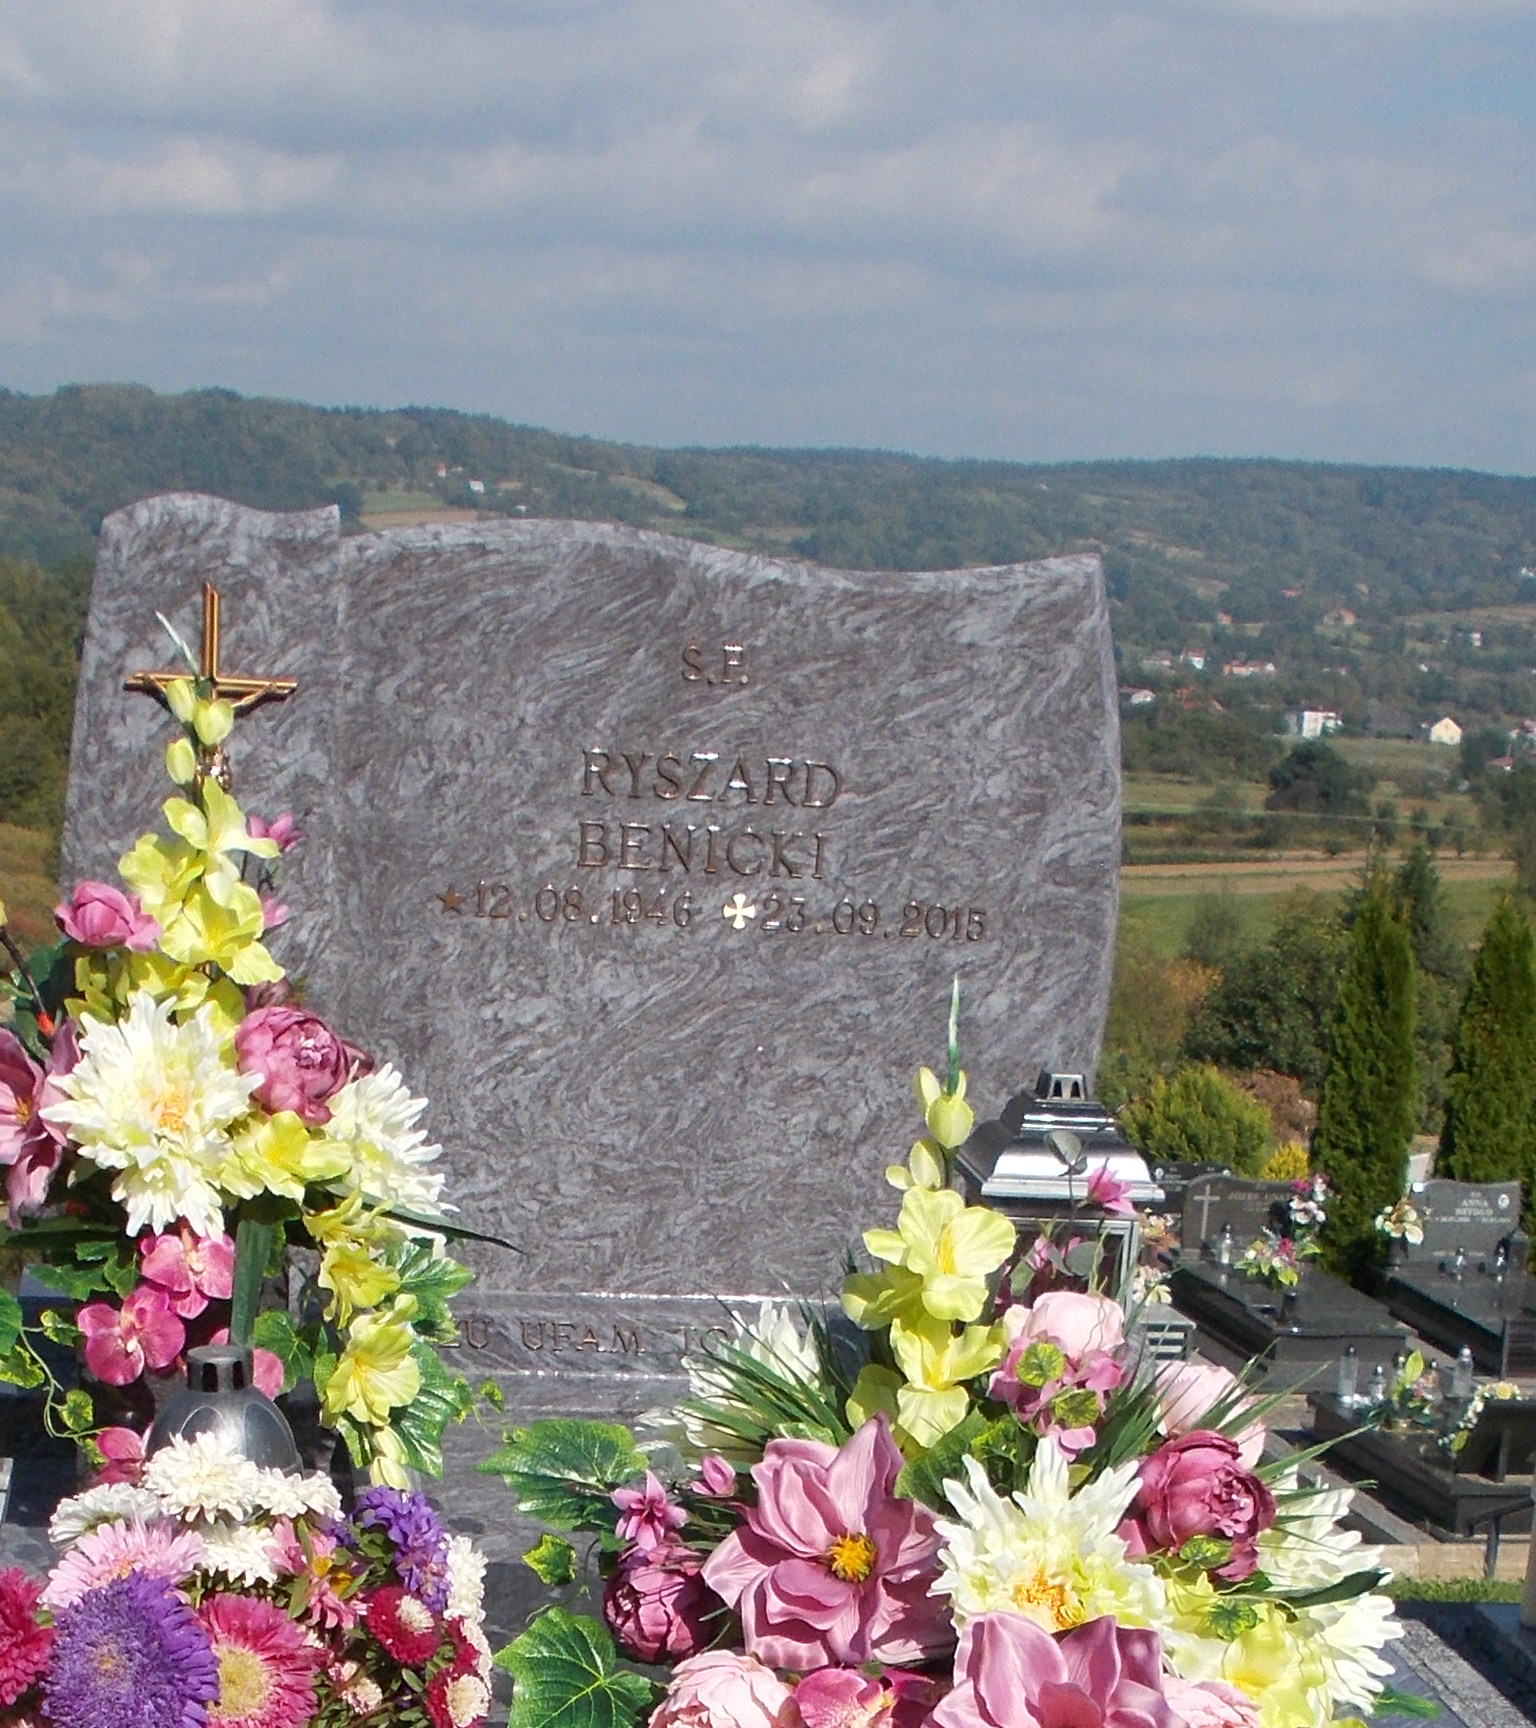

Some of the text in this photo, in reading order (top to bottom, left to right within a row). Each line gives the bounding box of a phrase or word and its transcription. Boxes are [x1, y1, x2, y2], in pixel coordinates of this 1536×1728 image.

[580, 746, 844, 808] RYSZARD
[576, 819, 830, 880] BENICKI
[520, 1319, 647, 1356] UFAM
